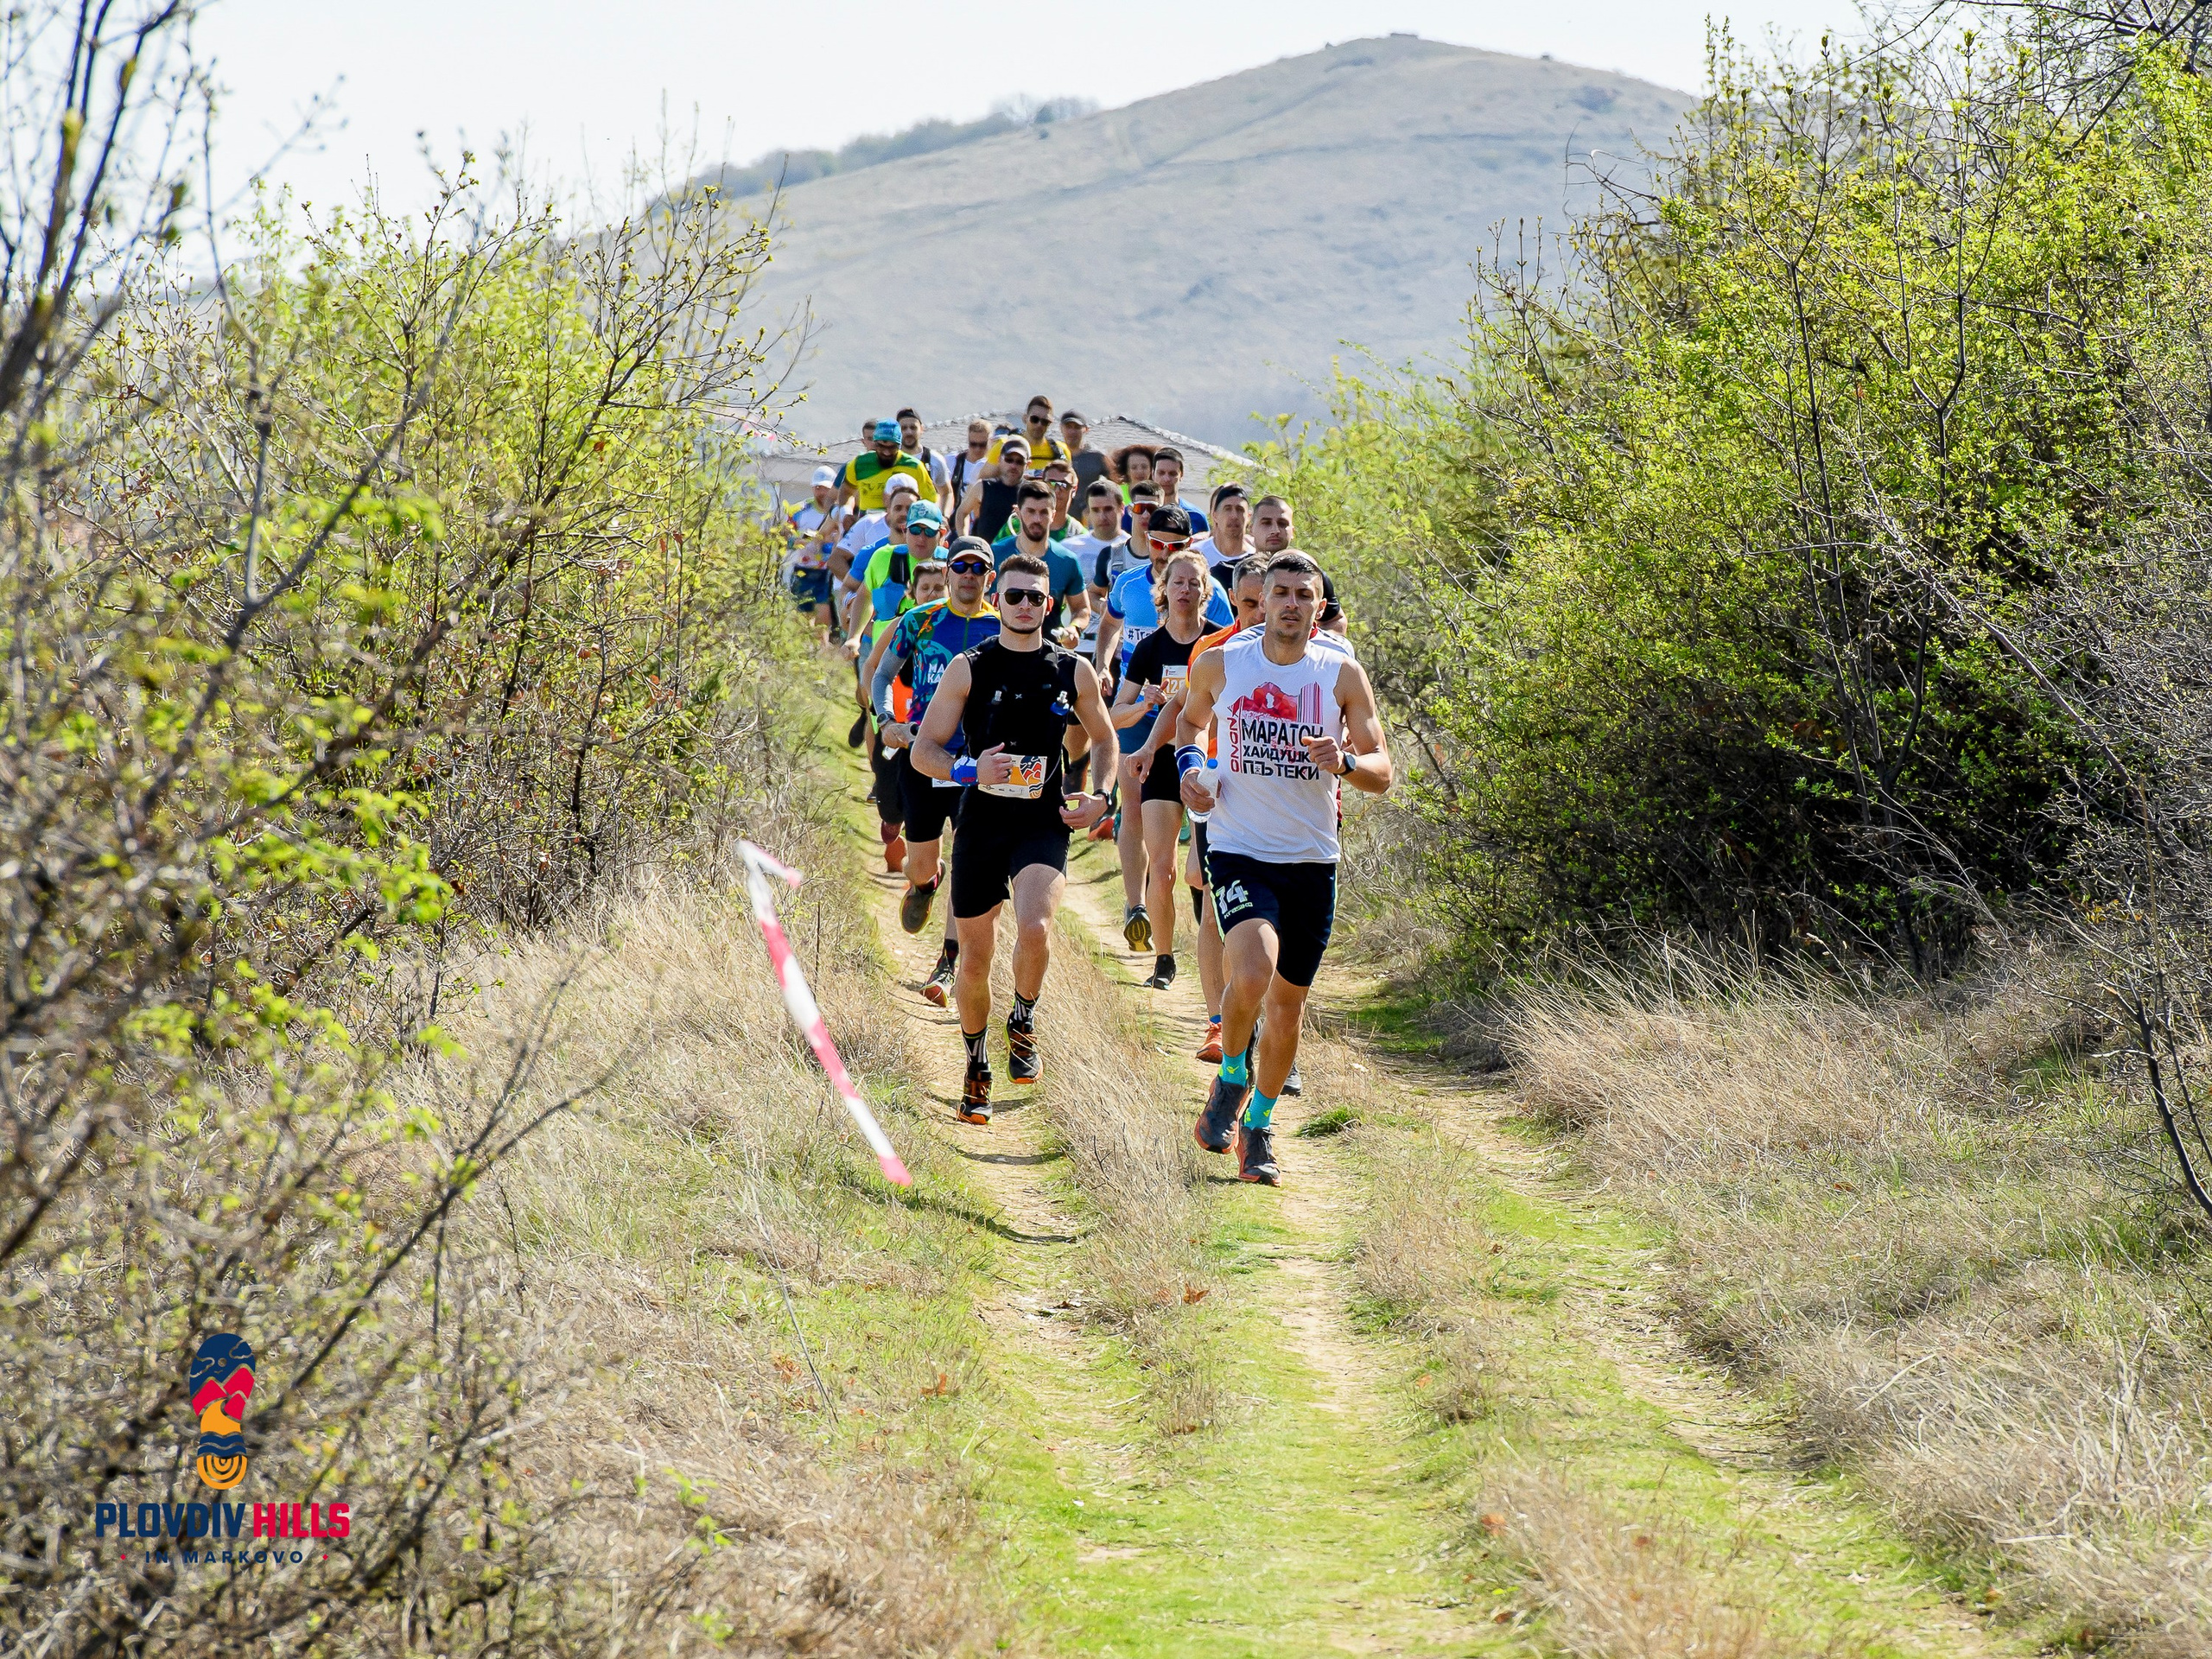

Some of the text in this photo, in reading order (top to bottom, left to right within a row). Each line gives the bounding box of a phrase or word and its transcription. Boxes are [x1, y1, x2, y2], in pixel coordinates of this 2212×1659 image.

[1128, 628, 1154, 640] #Tr
[1243, 744, 1312, 763] ХАЙДУШК
[1243, 760, 1320, 780] ПЪТЕКИ
